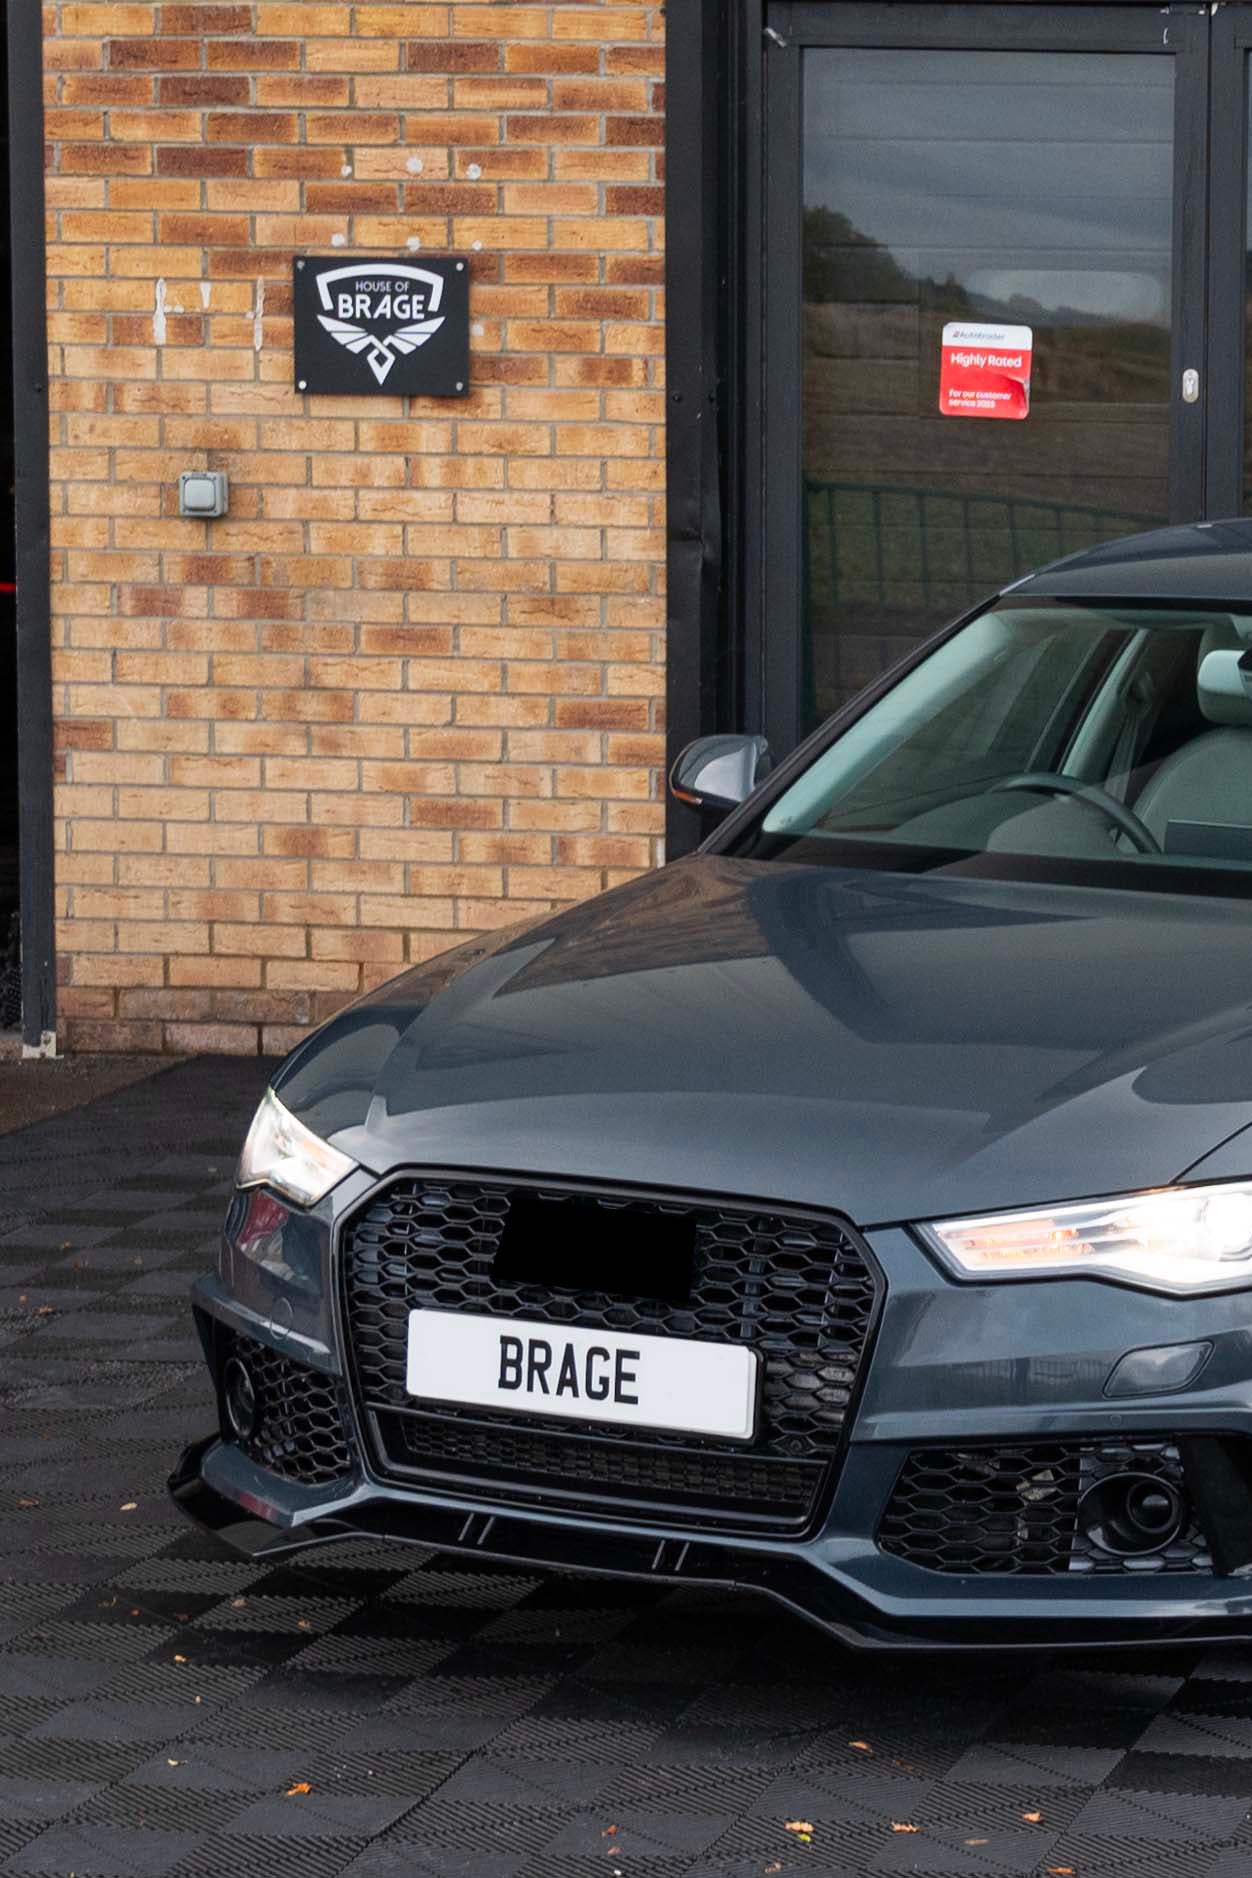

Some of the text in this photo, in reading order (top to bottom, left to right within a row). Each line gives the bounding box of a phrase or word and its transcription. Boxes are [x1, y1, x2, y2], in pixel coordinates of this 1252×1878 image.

[355, 280, 410, 293] HOUSE OF
[338, 293, 425, 320] BRAGE
[950, 352, 1022, 368] Highly Rated
[962, 390, 976, 399] our
[976, 391, 1012, 400] customer
[948, 399, 976, 408] service
[498, 1335, 641, 1405] BRAGE
